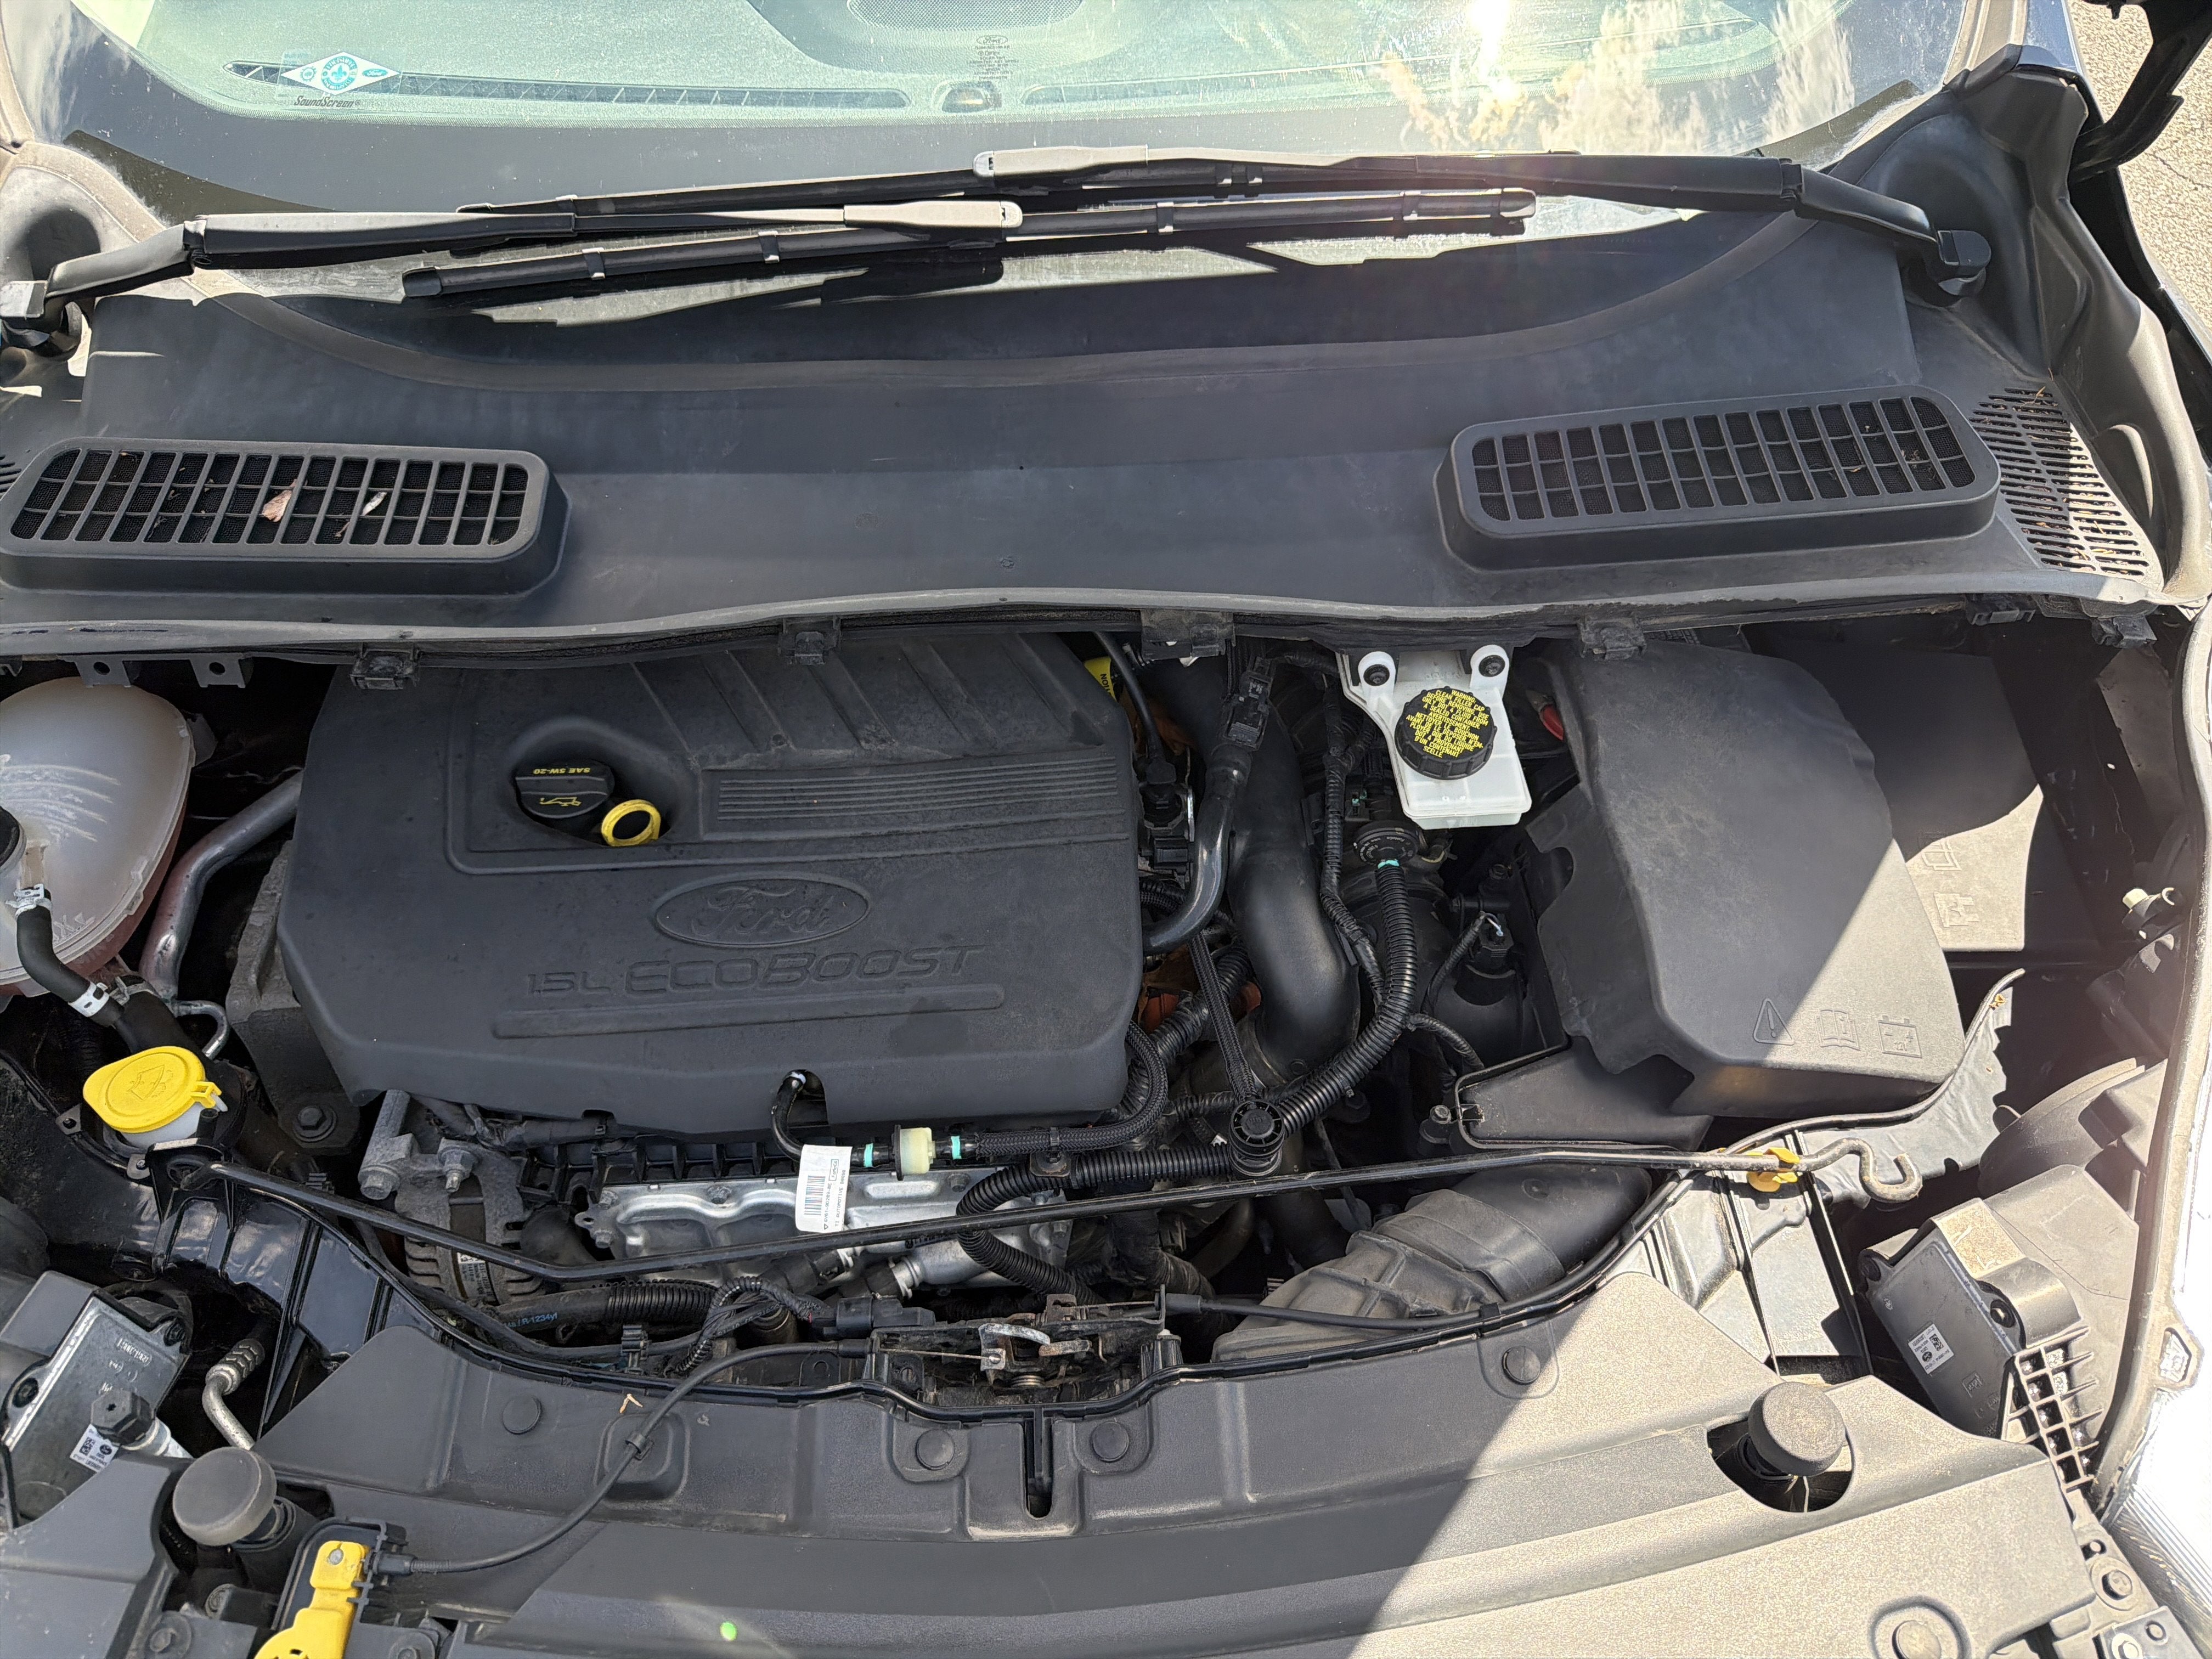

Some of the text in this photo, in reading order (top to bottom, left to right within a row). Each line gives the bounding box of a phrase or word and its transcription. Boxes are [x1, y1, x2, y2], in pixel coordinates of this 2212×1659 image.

[1422, 696, 1437, 706] ONLY
[1437, 702, 1449, 710] DOT
[1455, 709, 1472, 719] FLUID
[1472, 715, 1488, 726] FROM
[1426, 692, 1489, 720] BEFORE REMOVING. USE
[1435, 690, 1485, 712] CLEAN FILLER CAP
[1406, 714, 1425, 725] AVANT
[1415, 712, 1442, 726] NETTOYER
[1453, 726, 1480, 741] BOUCHON
[1429, 705, 1450, 717] SEALED
[1451, 713, 1480, 730] CONTAINER.
[1409, 721, 1431, 734] PLOYER
[1431, 730, 1443, 739] QUE
[1453, 739, 1475, 752] LIQUIDE
[1414, 736, 1460, 758] D'UN CONTENANT
[1415, 730, 1427, 738] DOT
[1432, 737, 1465, 753] PROVENANT
[691, 885, 831, 936] Ford
